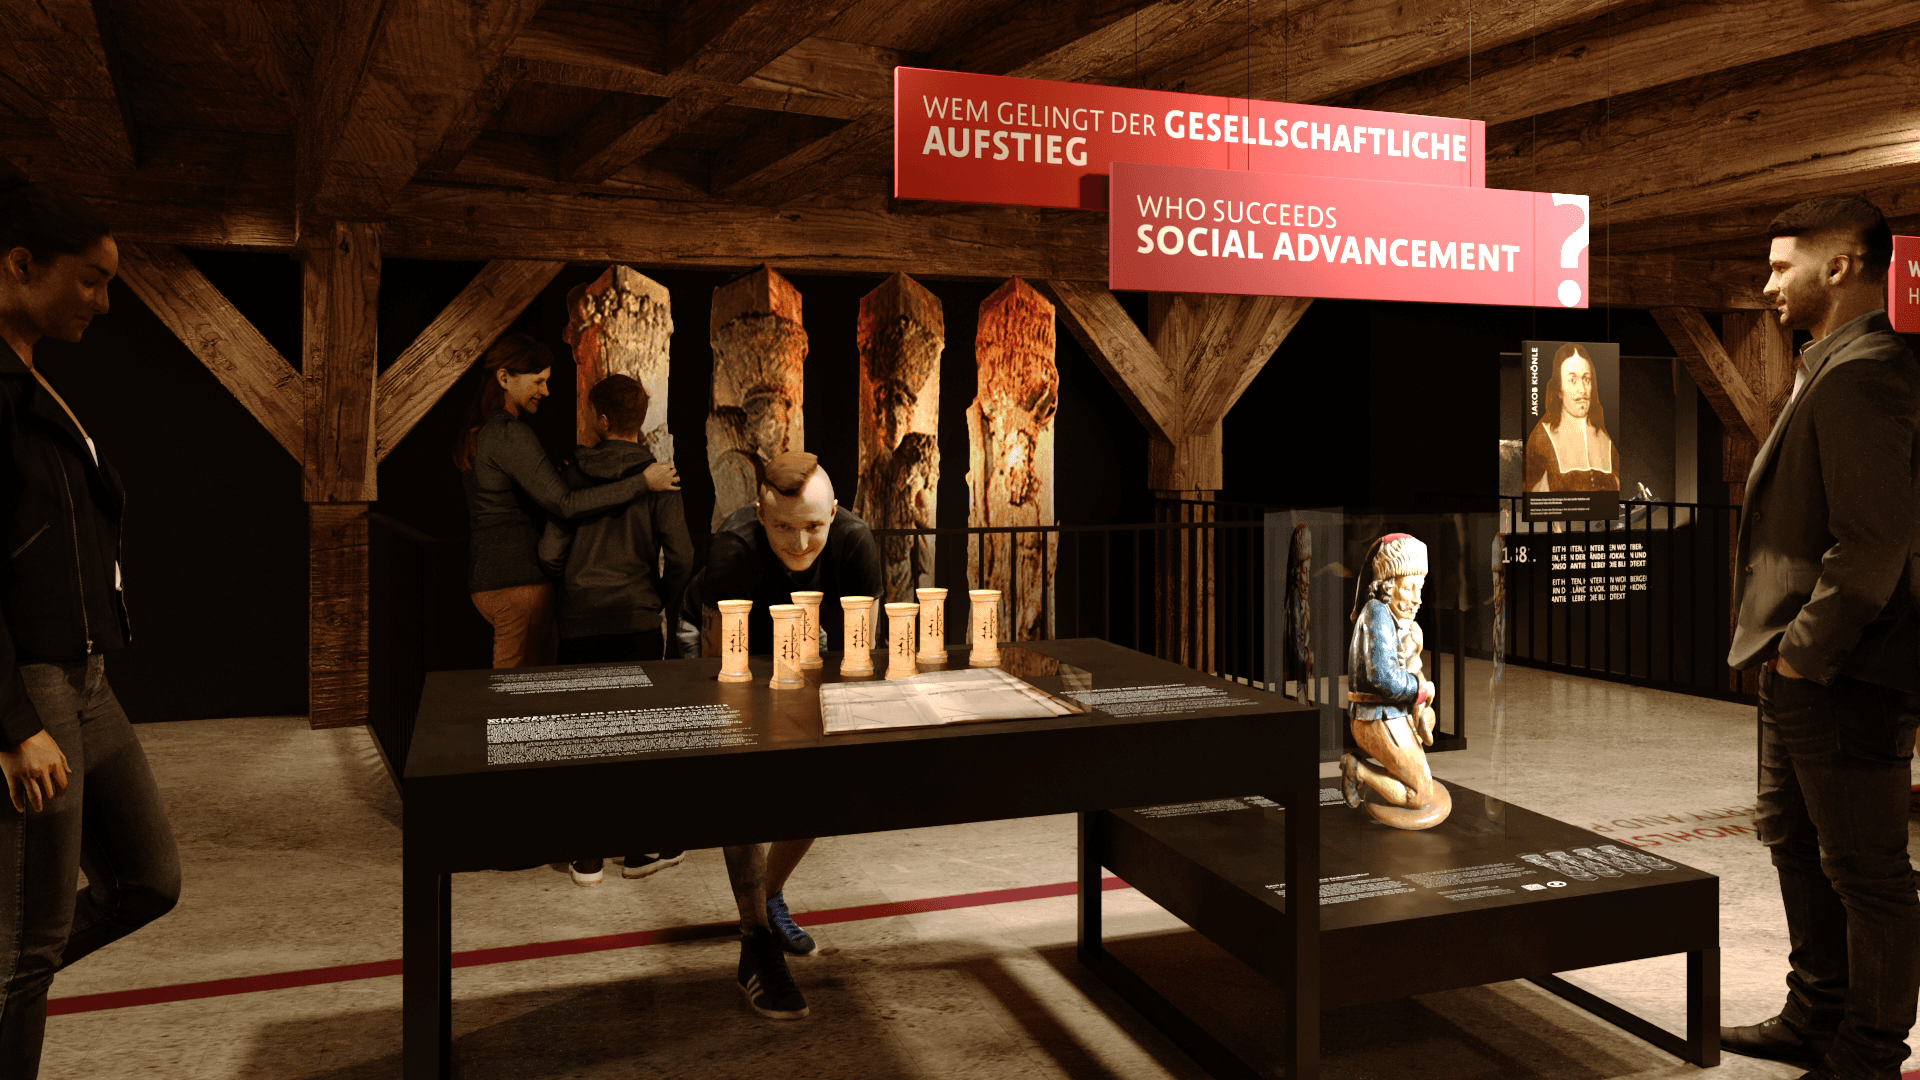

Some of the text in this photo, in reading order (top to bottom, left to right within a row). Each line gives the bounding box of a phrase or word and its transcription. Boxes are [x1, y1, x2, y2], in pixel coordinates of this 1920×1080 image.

[923, 96, 1468, 162] WEM GELINGT DER GESELLSCHAFTLICHE
[923, 124, 1088, 166] AUFSTIEG
[1137, 195, 1337, 229] WHO SUCCEEDS
[1137, 224, 1520, 273] SOCIAL ADVANCEMENT
[1908, 260, 1920, 277] W
[1908, 287, 1920, 305] H
[1611, 814, 1686, 829] AND
[1616, 824, 1758, 848] WOHLST
